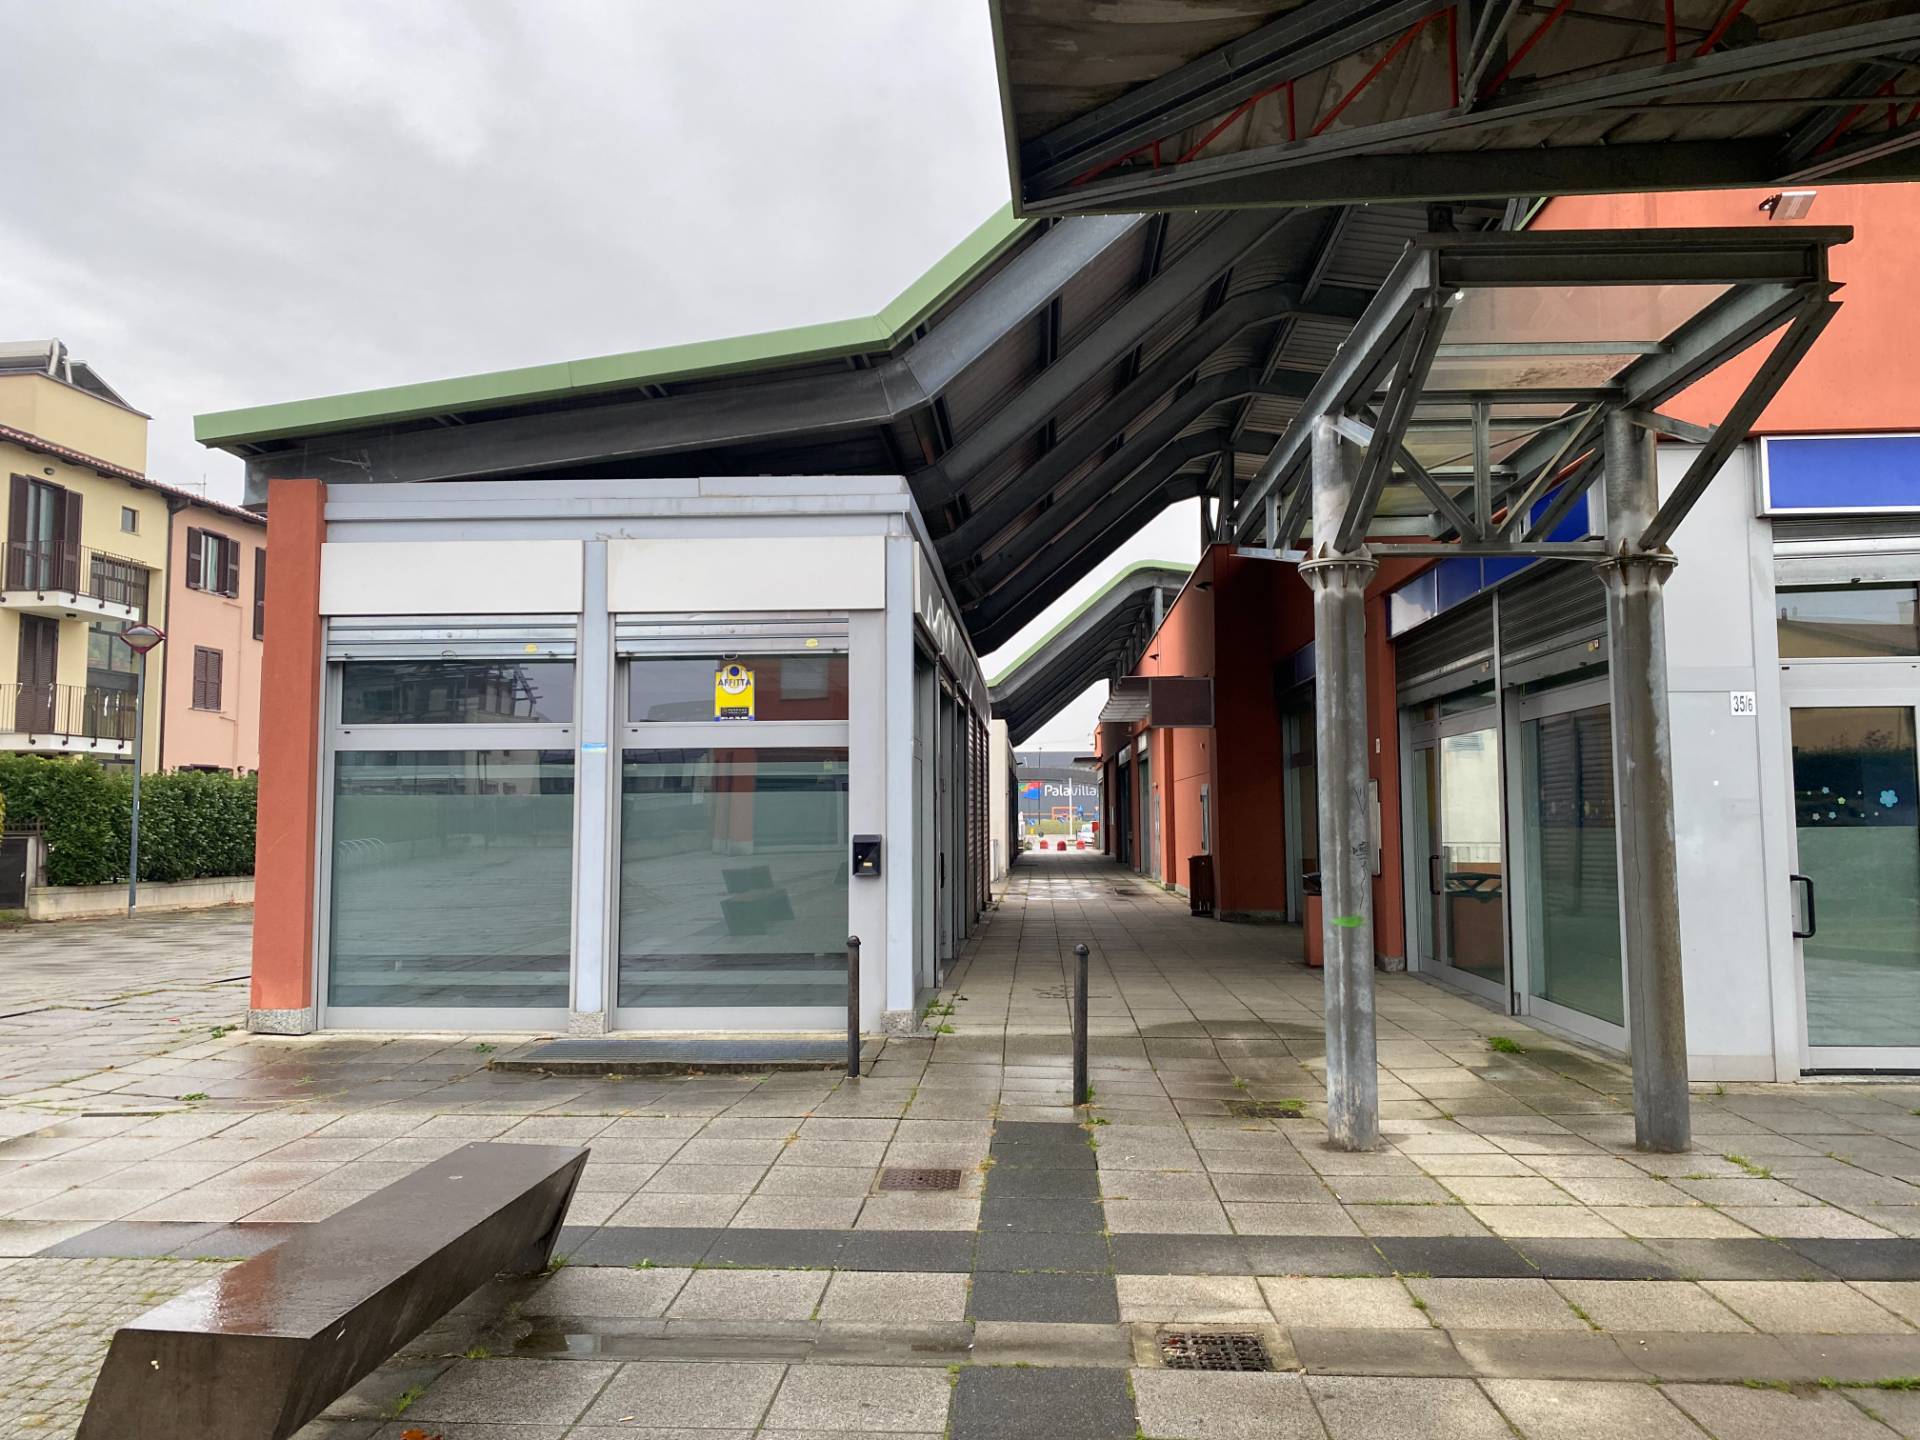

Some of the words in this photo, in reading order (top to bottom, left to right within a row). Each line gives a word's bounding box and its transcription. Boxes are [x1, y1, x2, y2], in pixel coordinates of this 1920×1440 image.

[718, 679, 751, 687] AFFITTA
[1733, 695, 1753, 712] 35/6
[1044, 784, 1098, 797] Palavilla
